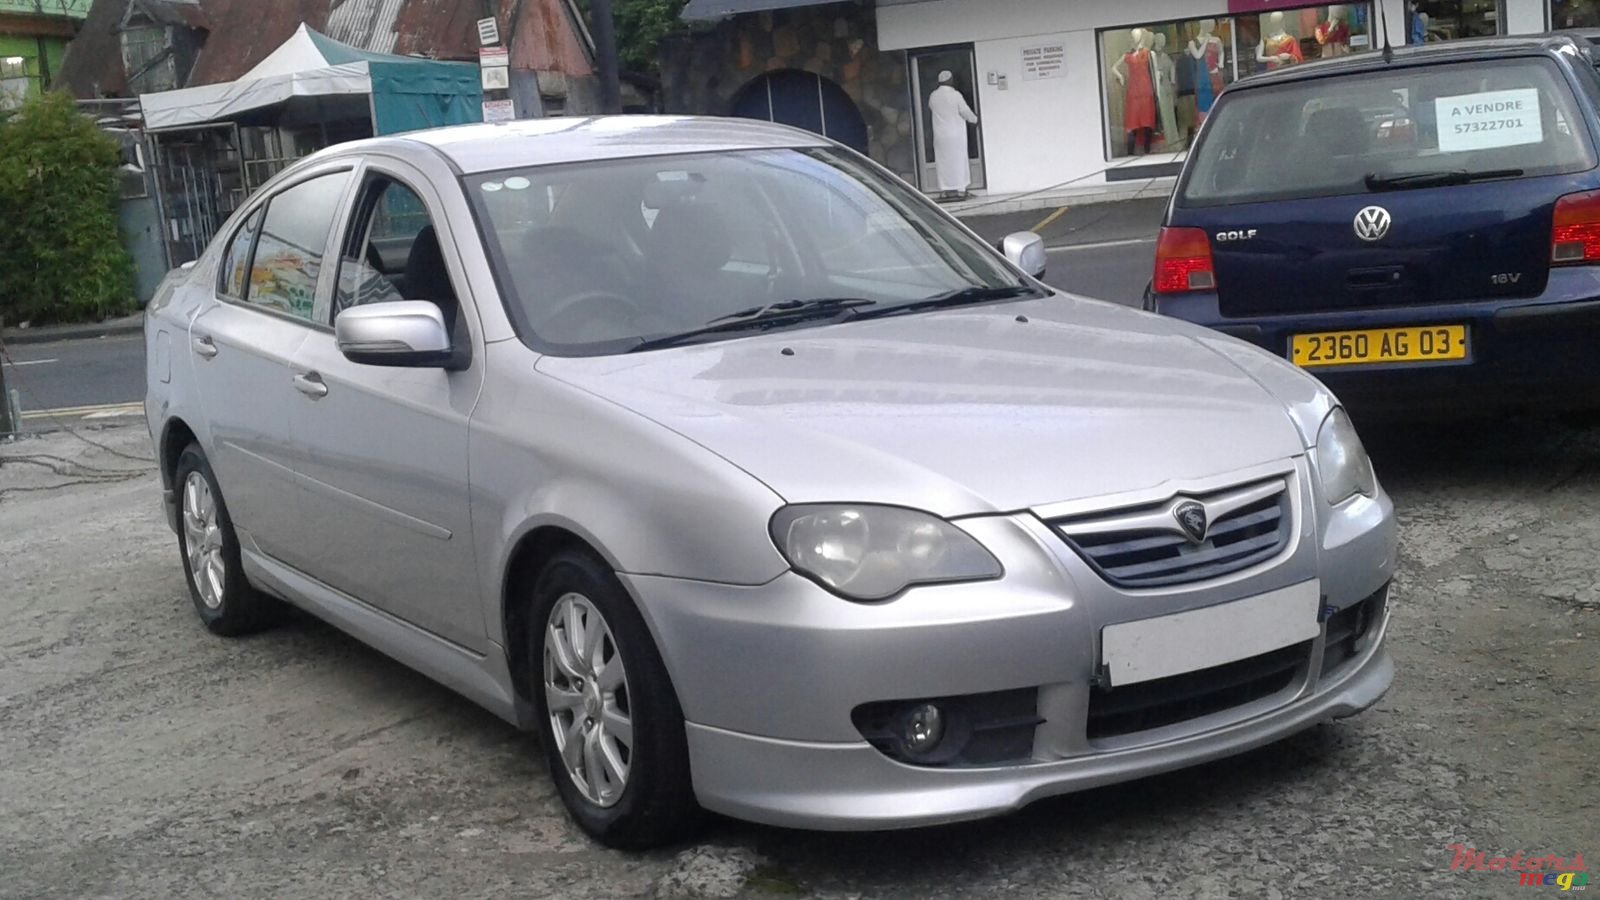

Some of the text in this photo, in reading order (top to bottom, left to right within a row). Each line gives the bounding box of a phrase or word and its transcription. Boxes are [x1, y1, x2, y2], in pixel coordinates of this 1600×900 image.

[1451, 100, 1524, 117] A VENDRE
[1454, 118, 1524, 134] 57322701
[1216, 229, 1257, 242] GOLF
[1308, 329, 1450, 361] 2360 AG 03
